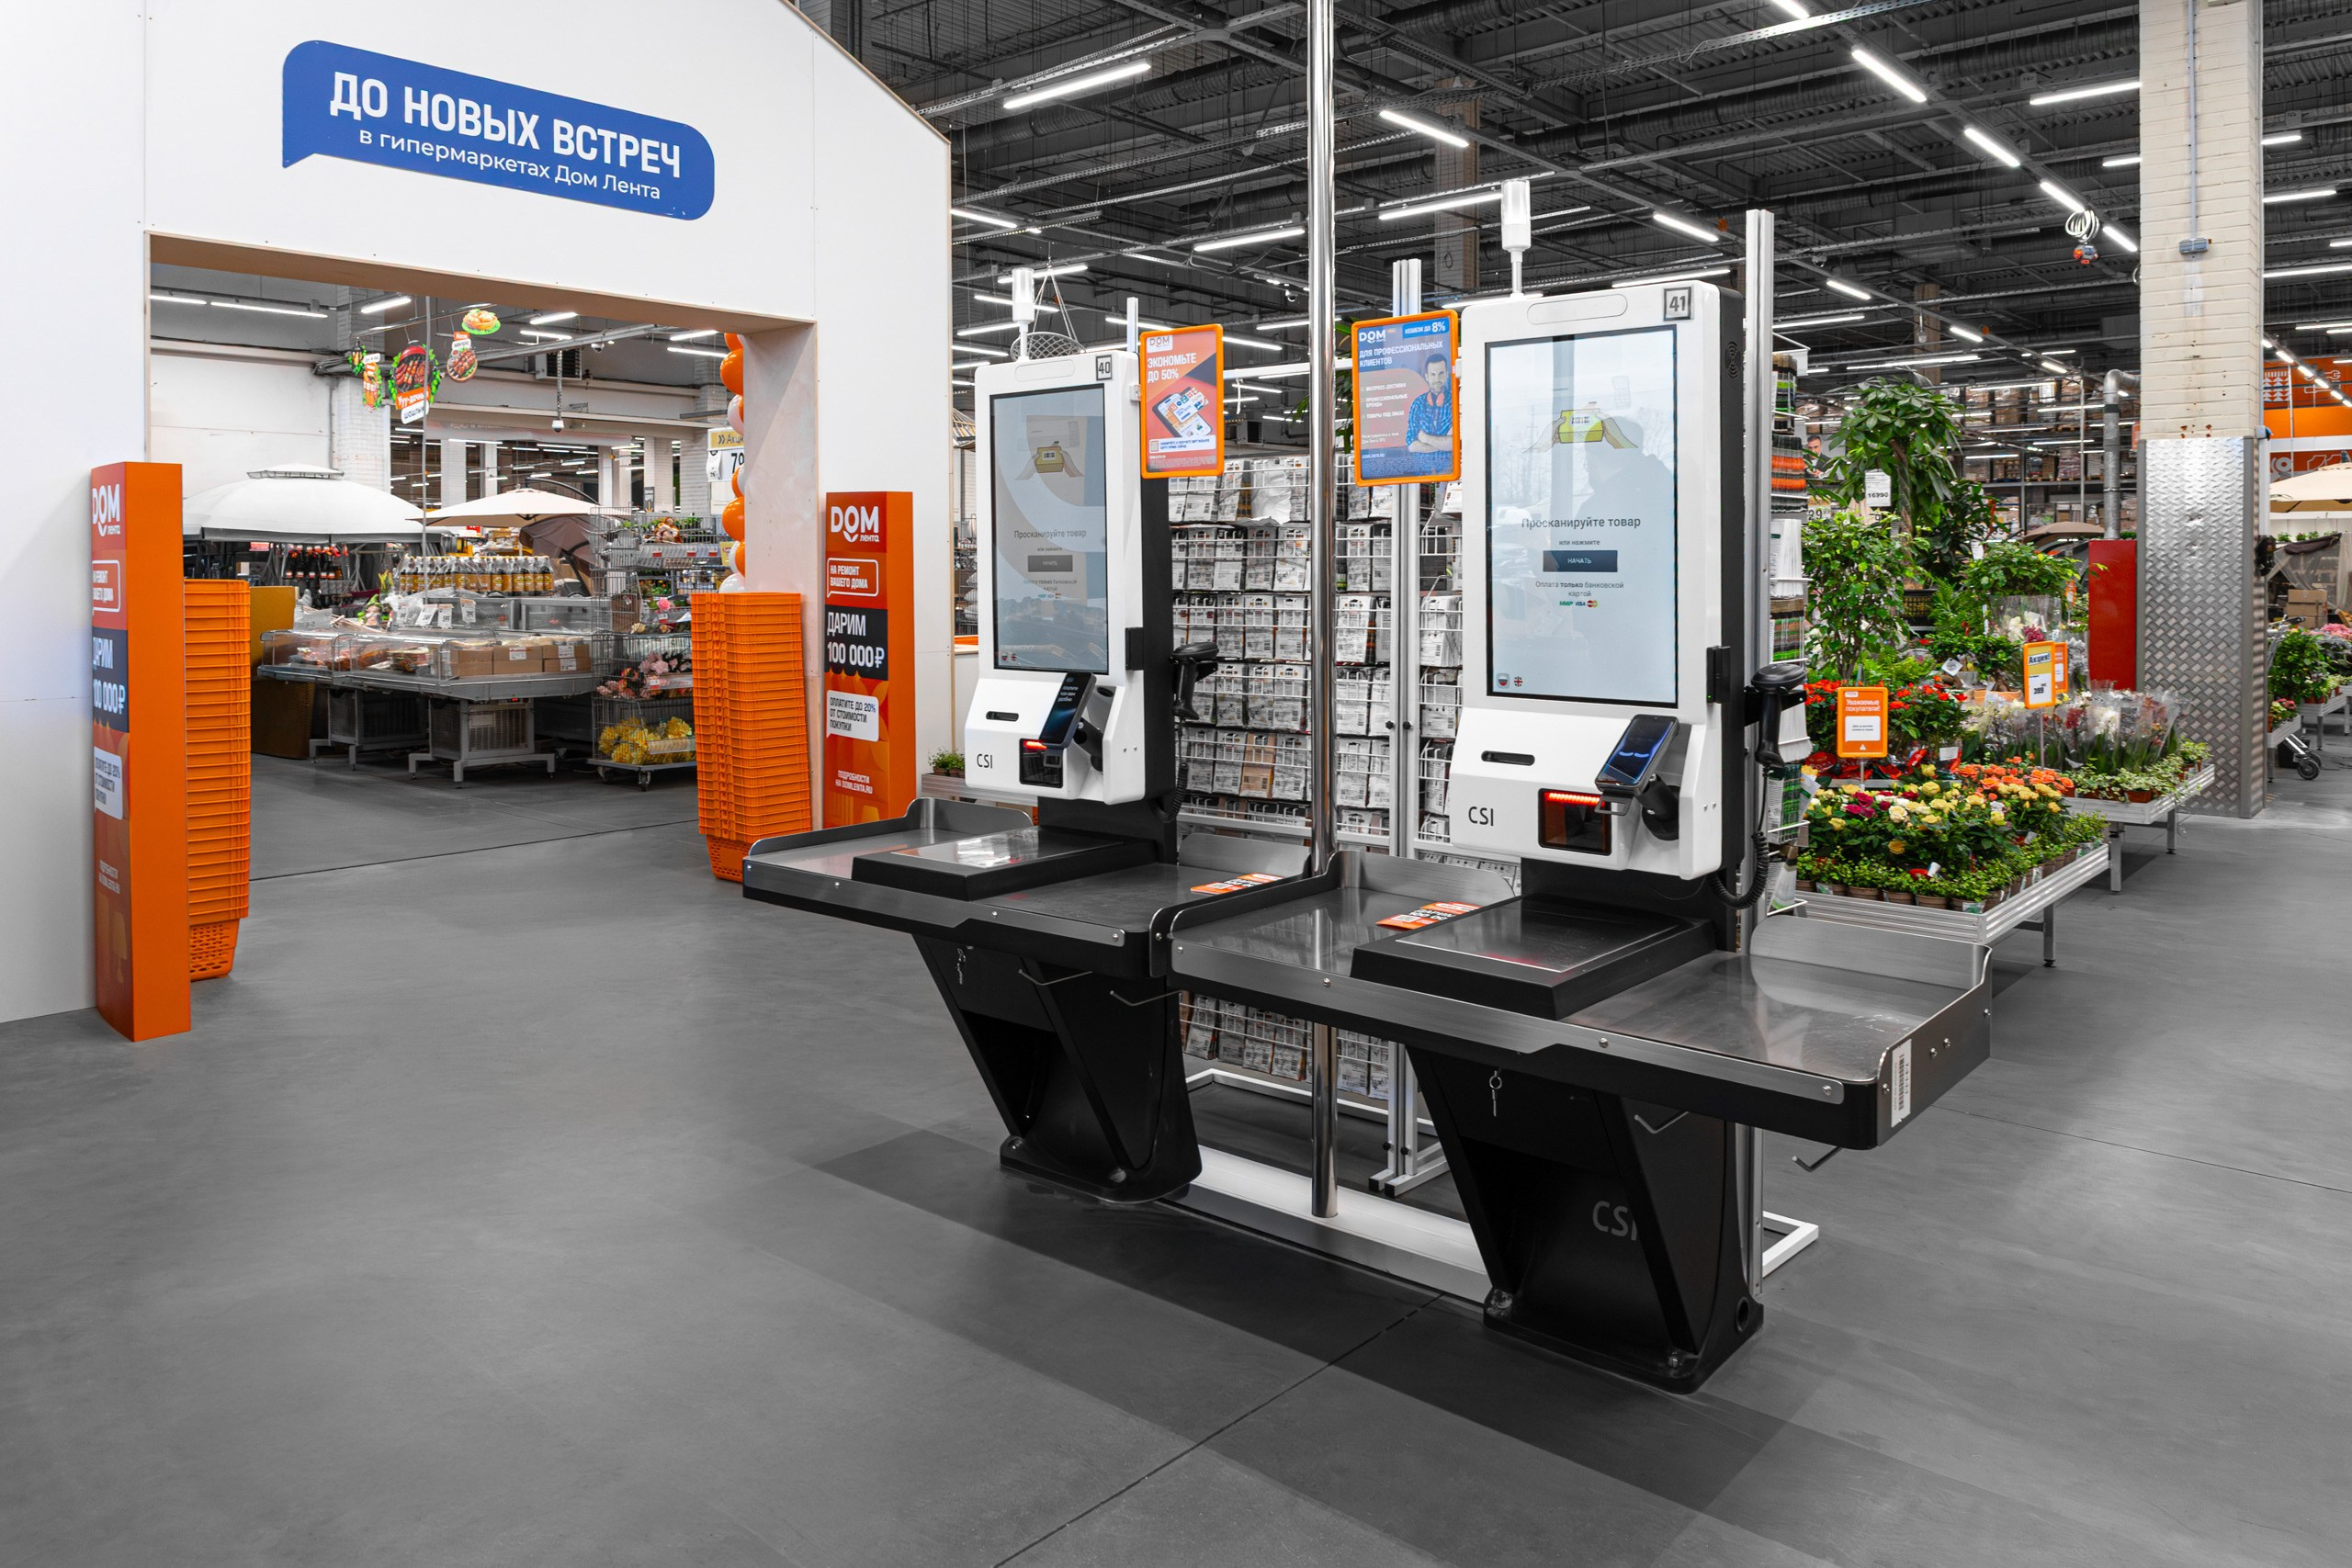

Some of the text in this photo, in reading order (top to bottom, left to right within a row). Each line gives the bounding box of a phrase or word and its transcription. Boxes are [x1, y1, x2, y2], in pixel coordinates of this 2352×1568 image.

[329, 71, 680, 178] ДО НОВЫХ ВСТРЕЧ
[359, 130, 661, 200] в гипермаркетах Дом Лента
[1668, 295, 1687, 312] 41
[1431, 321, 1446, 333] 8%
[1359, 329, 1386, 343] DOM
[1359, 340, 1443, 359] ДЛЯ ПРОФЕССИОНАЛЬНЫХ
[1098, 361, 1111, 375] 40
[1147, 352, 1197, 369] ЭКОНОМЬТЕ
[1359, 356, 1393, 367] КЛИЕНТОВ
[1147, 368, 1180, 384] ДО 50%
[831, 505, 879, 534] DOM
[1521, 516, 1641, 531] Просканируйте товар
[1013, 529, 1087, 539] Просканируйте товар
[838, 565, 860, 576] РЕМОНТ
[830, 577, 868, 590] ВАШЕГО ДОМА
[1535, 581, 1559, 589] Оплата
[1584, 581, 1624, 589] банковской
[827, 612, 866, 637] ДАРИМ
[827, 641, 846, 664] 100
[855, 701, 864, 713] ДО
[864, 702, 876, 714] 20%
[830, 708, 867, 724] ОТ СТОИМОСТИ
[830, 719, 852, 732] ПОКУПКИ
[977, 753, 993, 770] CSI
[1468, 806, 1495, 827] CSI
[1592, 1200, 1638, 1241] CSI
